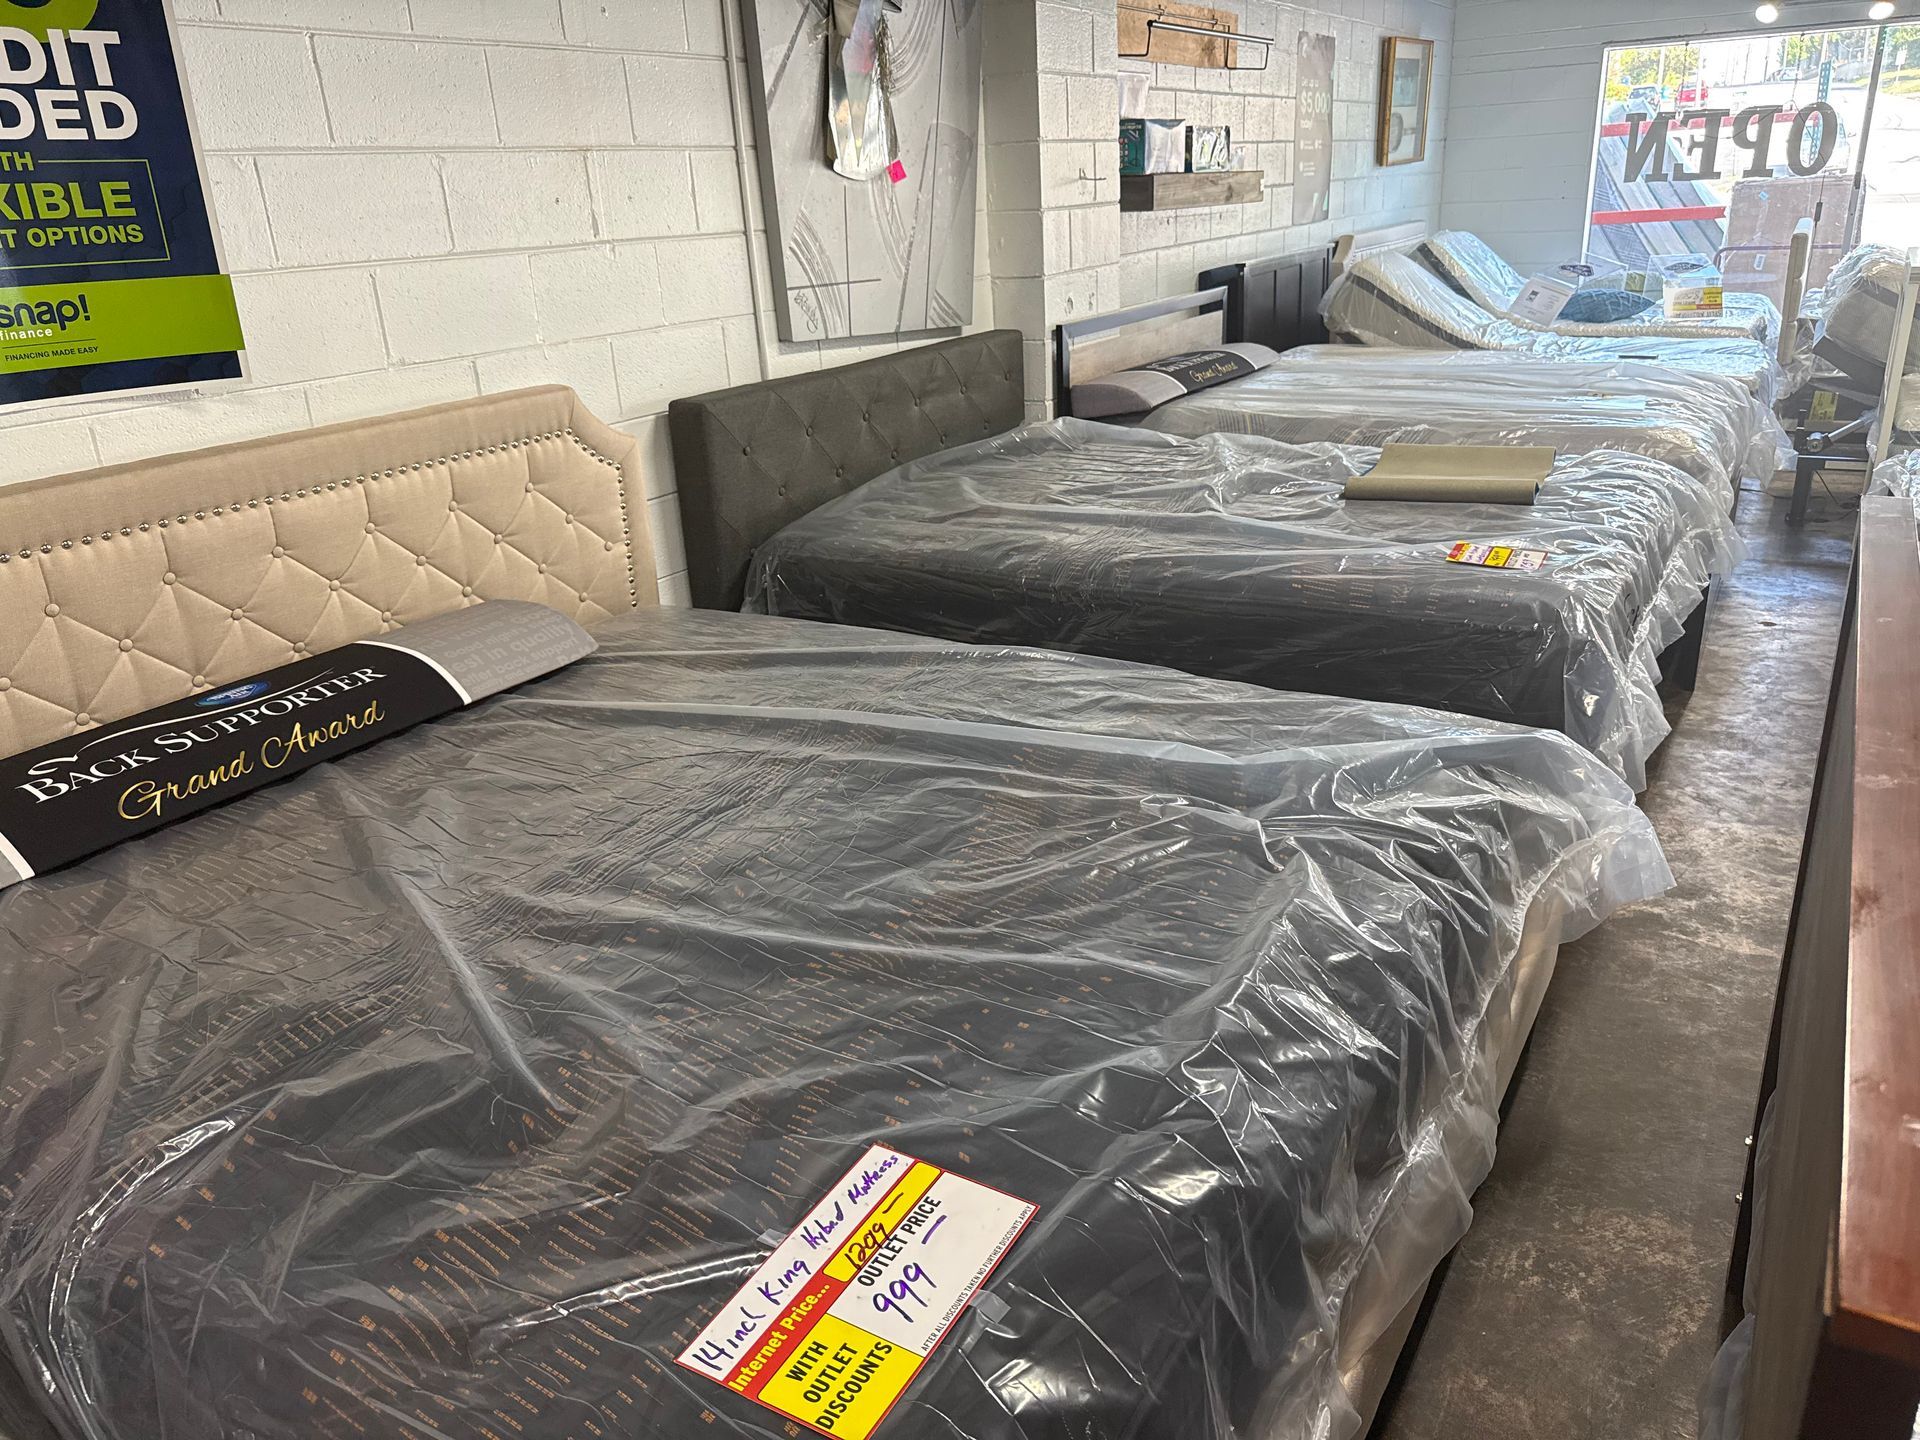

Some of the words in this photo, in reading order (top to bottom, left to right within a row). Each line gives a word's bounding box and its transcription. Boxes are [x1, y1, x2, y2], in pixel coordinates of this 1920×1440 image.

[0, 27, 121, 86] DIT
[0, 88, 138, 140] DED
[26, 224, 144, 247] OPTIONS
[0, 294, 91, 331] snap!
[0, 328, 53, 341] finance
[5, 352, 50, 361] FINANCING
[52, 348, 76, 357] MADE
[77, 346, 99, 354] EASY
[510, 622, 575, 654] quality
[530, 636, 580, 660] support
[15, 748, 161, 804] BACK
[154, 665, 387, 754] SUPPORTER
[118, 750, 254, 820] Grand
[260, 700, 385, 769] Award
[845, 1222, 890, 1270] 1299
[857, 1234, 908, 1287] OUTLET
[900, 1196, 941, 1235] PRICE
[873, 1263, 937, 1323] 999
[921, 1332, 938, 1351] AFTER
[936, 1320, 947, 1334] ALL
[943, 1295, 965, 1322] DISCOUNTS
[964, 1275, 981, 1298] TAKEN
[977, 1267, 987, 1278] NO
[983, 1245, 1003, 1269] FURTHER
[999, 1220, 1022, 1247] DISCOUNTS
[1019, 1205, 1032, 1220] APPLY
[692, 1340, 734, 1371] 14
[757, 1260, 811, 1305] King
[727, 1331, 788, 1391] Internet
[785, 1341, 828, 1382] WITH
[803, 1342, 858, 1403] OUTLET
[815, 1341, 892, 1430] DISCOUNTS
